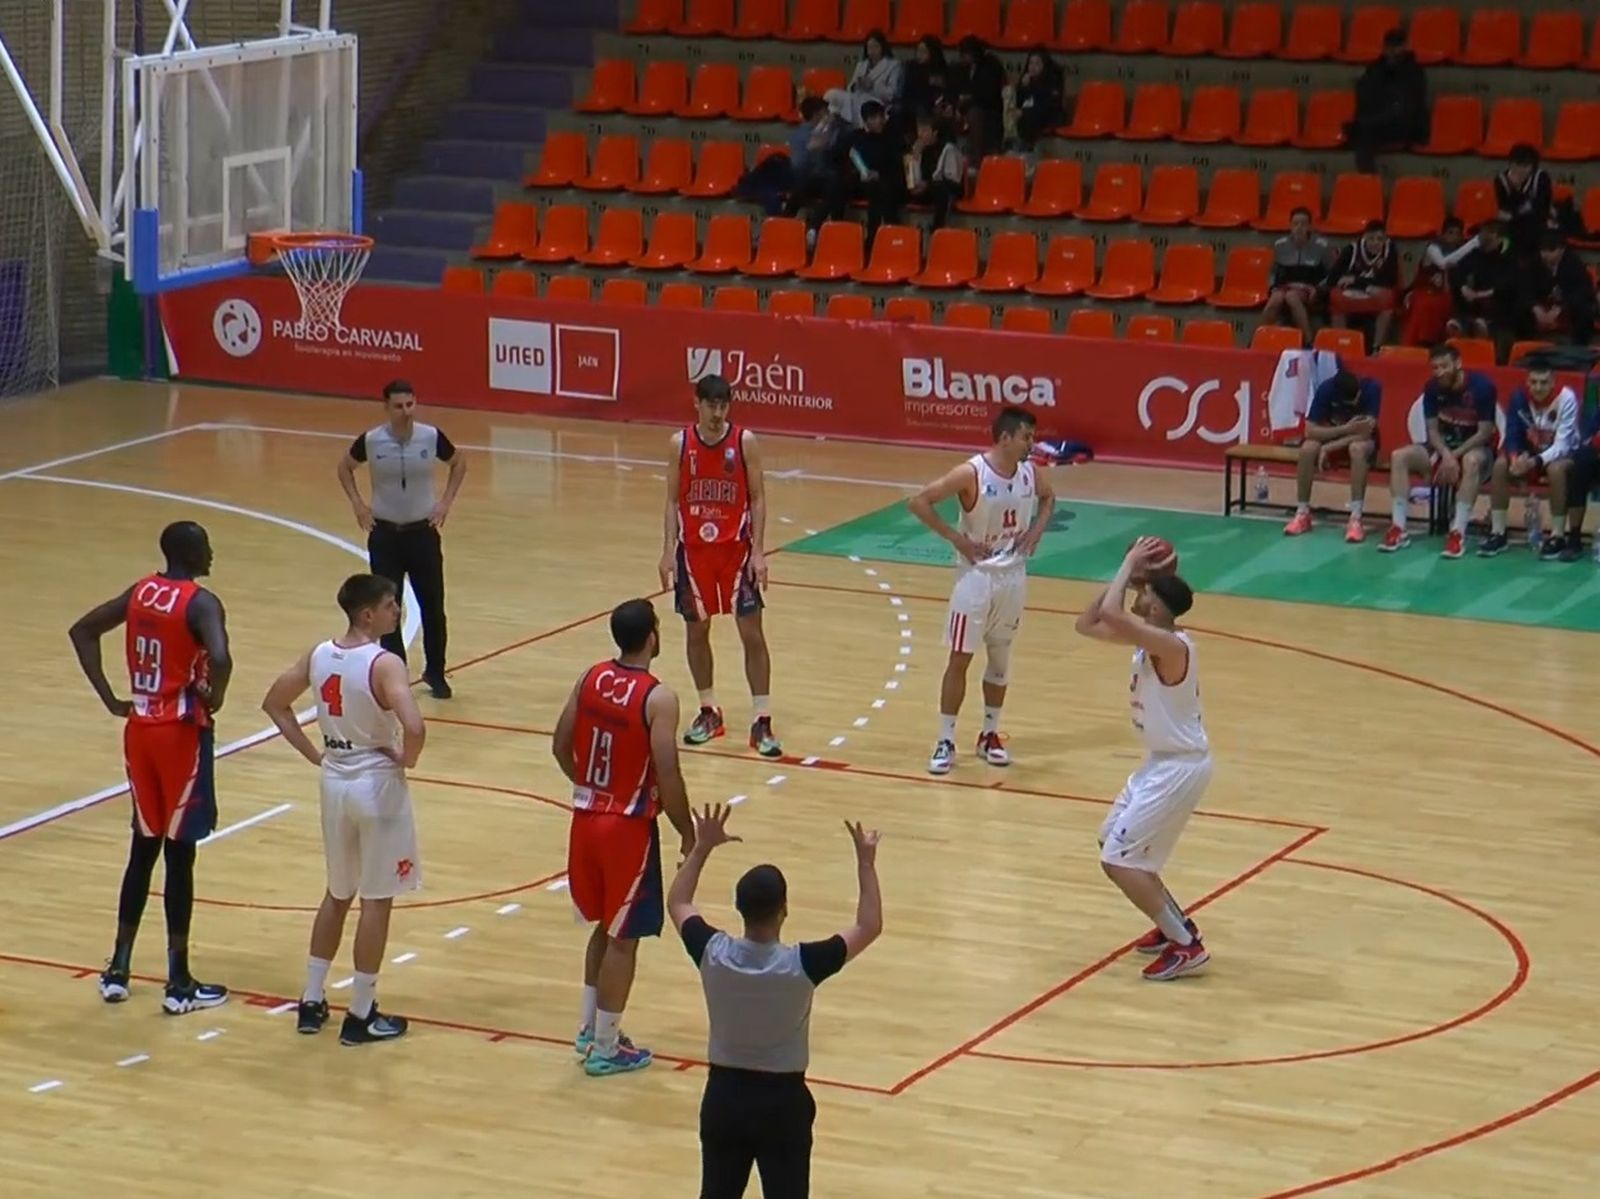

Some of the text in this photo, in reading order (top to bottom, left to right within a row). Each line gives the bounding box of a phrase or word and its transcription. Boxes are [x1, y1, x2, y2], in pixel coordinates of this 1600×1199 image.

[273, 320, 423, 351] PABLO CARVAJAL
[495, 343, 545, 367] UNED
[727, 350, 804, 392] Jaén
[902, 356, 1057, 407] Blanca
[779, 393, 833, 410] INTERIOR
[1002, 509, 1017, 528] 11
[321, 673, 343, 717] 4
[586, 726, 613, 787] 13
